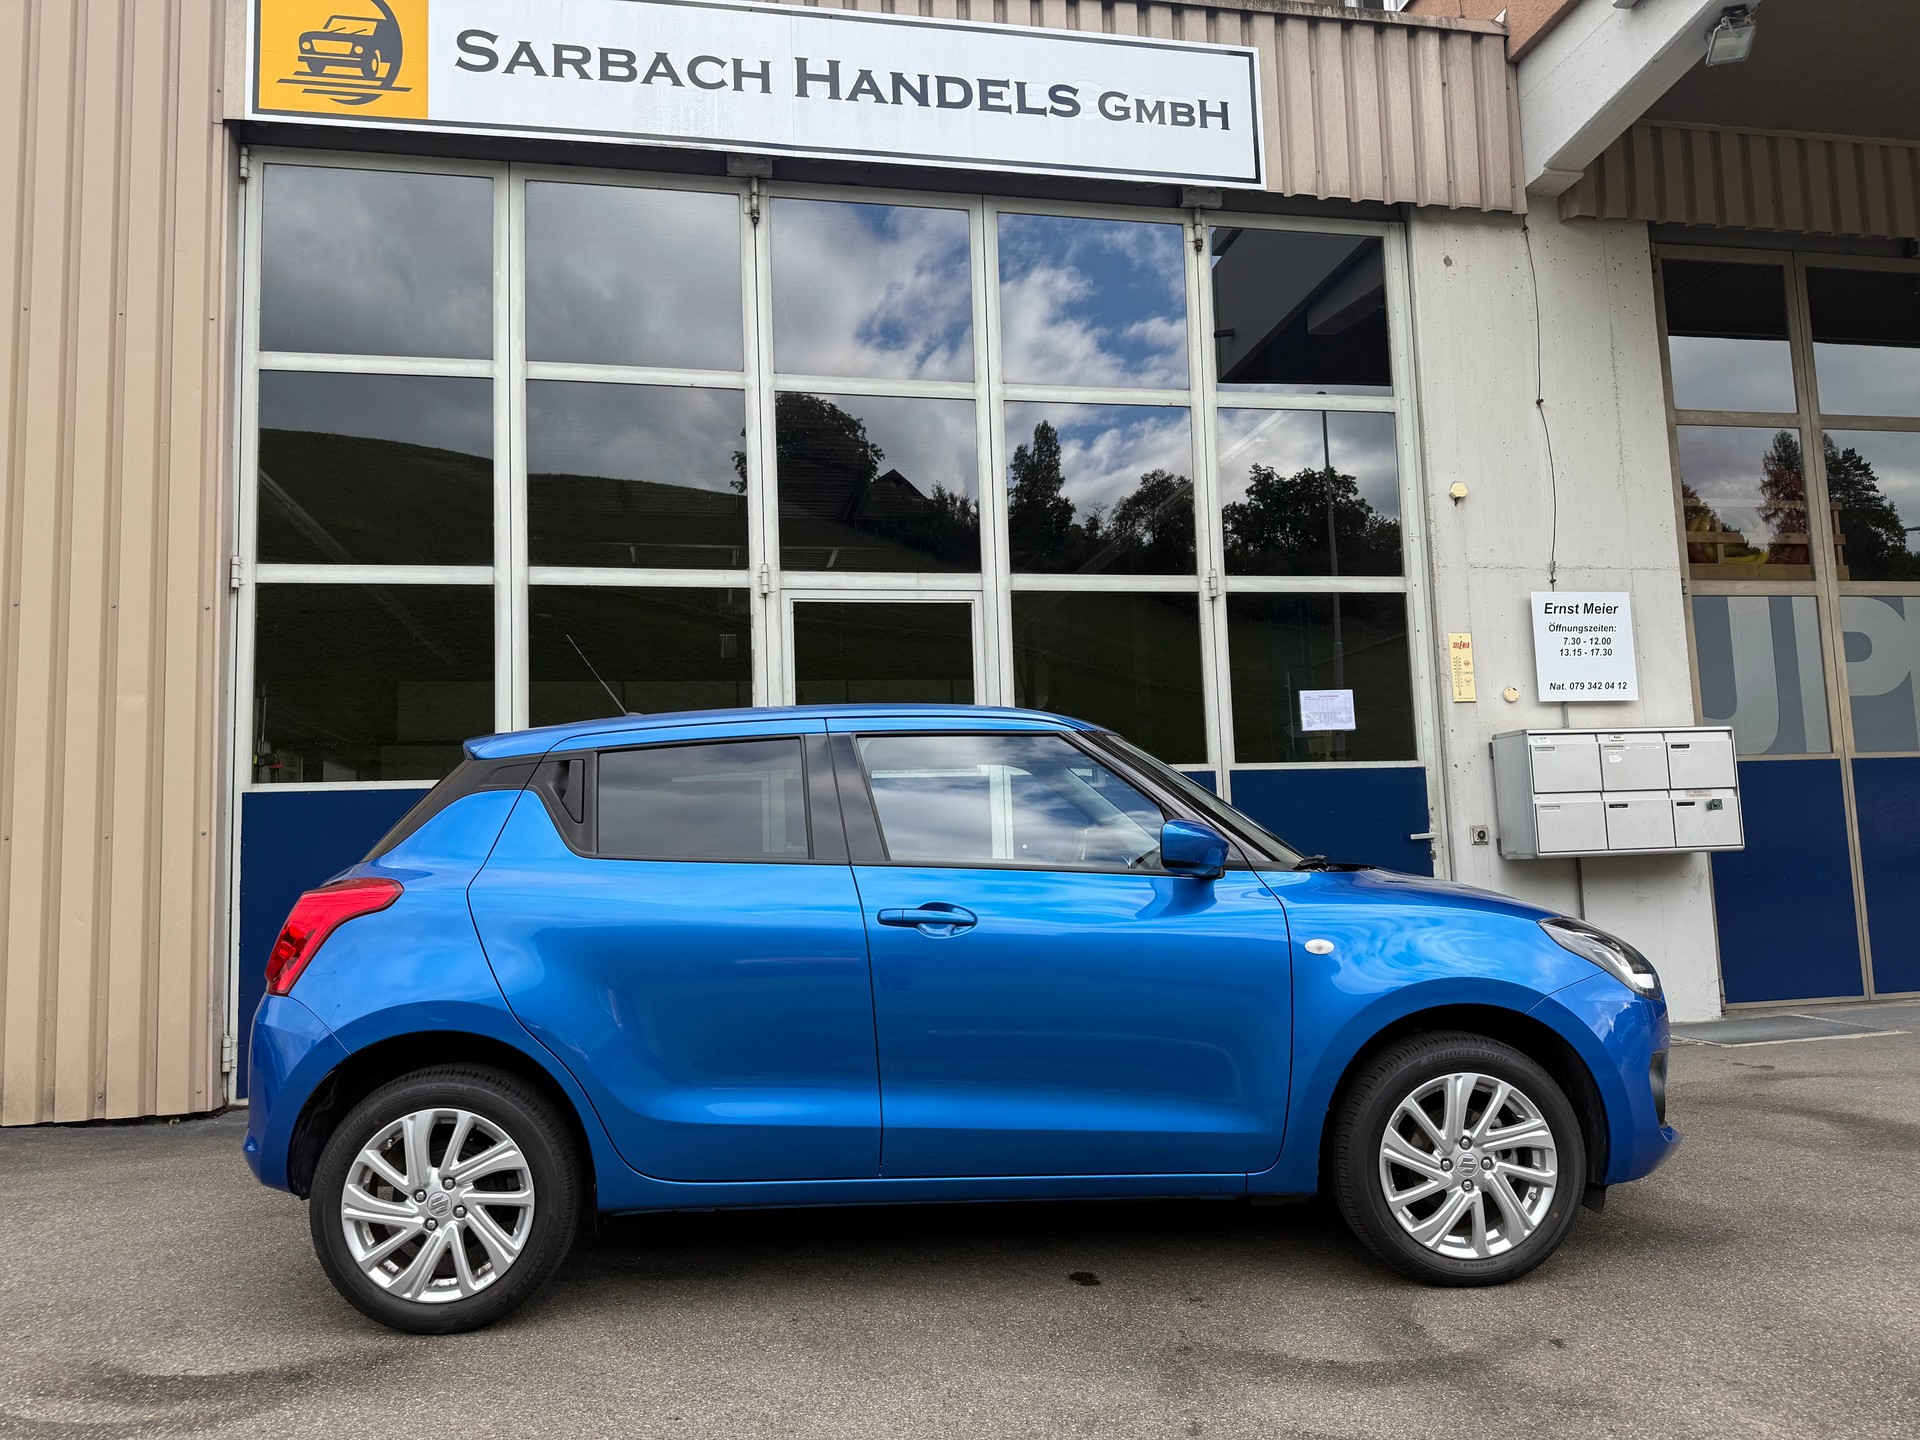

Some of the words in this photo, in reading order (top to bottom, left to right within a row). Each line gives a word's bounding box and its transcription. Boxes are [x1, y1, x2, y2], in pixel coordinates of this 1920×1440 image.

[1544, 602, 1580, 615] Ernst
[1583, 602, 1619, 615] Meier
[1548, 621, 1617, 634] Öffnungszeiten:
[1563, 637, 1581, 646] 7.30
[1589, 637, 1612, 646] 12.00
[1559, 648, 1582, 657] 13.15
[1590, 648, 1613, 657] 17.30
[1549, 682, 1567, 690] Nat.
[1569, 682, 1585, 690] 079
[1587, 682, 1603, 690] 342
[1604, 682, 1615, 690] 04
[1617, 682, 1628, 690] 12
[1426, 1049, 1512, 1065] BRIDGESTONE
[319, 1110, 370, 1194] BRIDGESTONE
